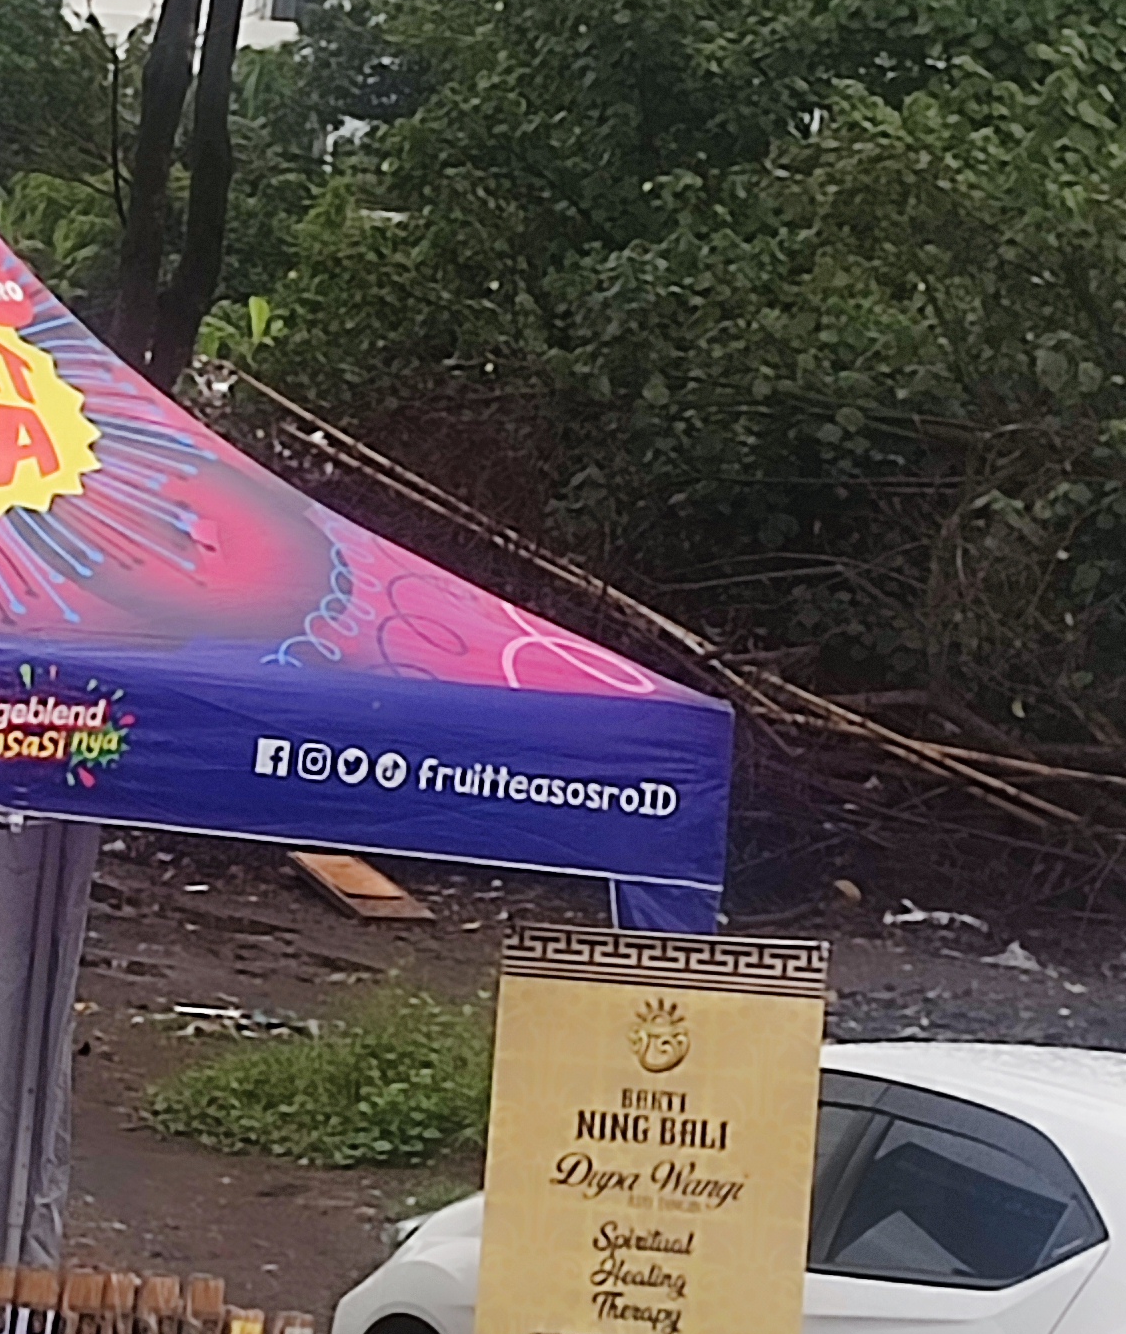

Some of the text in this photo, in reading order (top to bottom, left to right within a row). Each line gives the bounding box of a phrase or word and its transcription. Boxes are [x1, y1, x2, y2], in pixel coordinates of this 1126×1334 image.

[417, 756, 677, 817] fruitteasosroID
[621, 1087, 688, 1114] BAKTI
[575, 1109, 729, 1152] NING BALI
[549, 1151, 642, 1200] Dupa
[649, 1159, 751, 1209] Wangi
[592, 1219, 696, 1259] Spiritual
[589, 1255, 688, 1302] Healing
